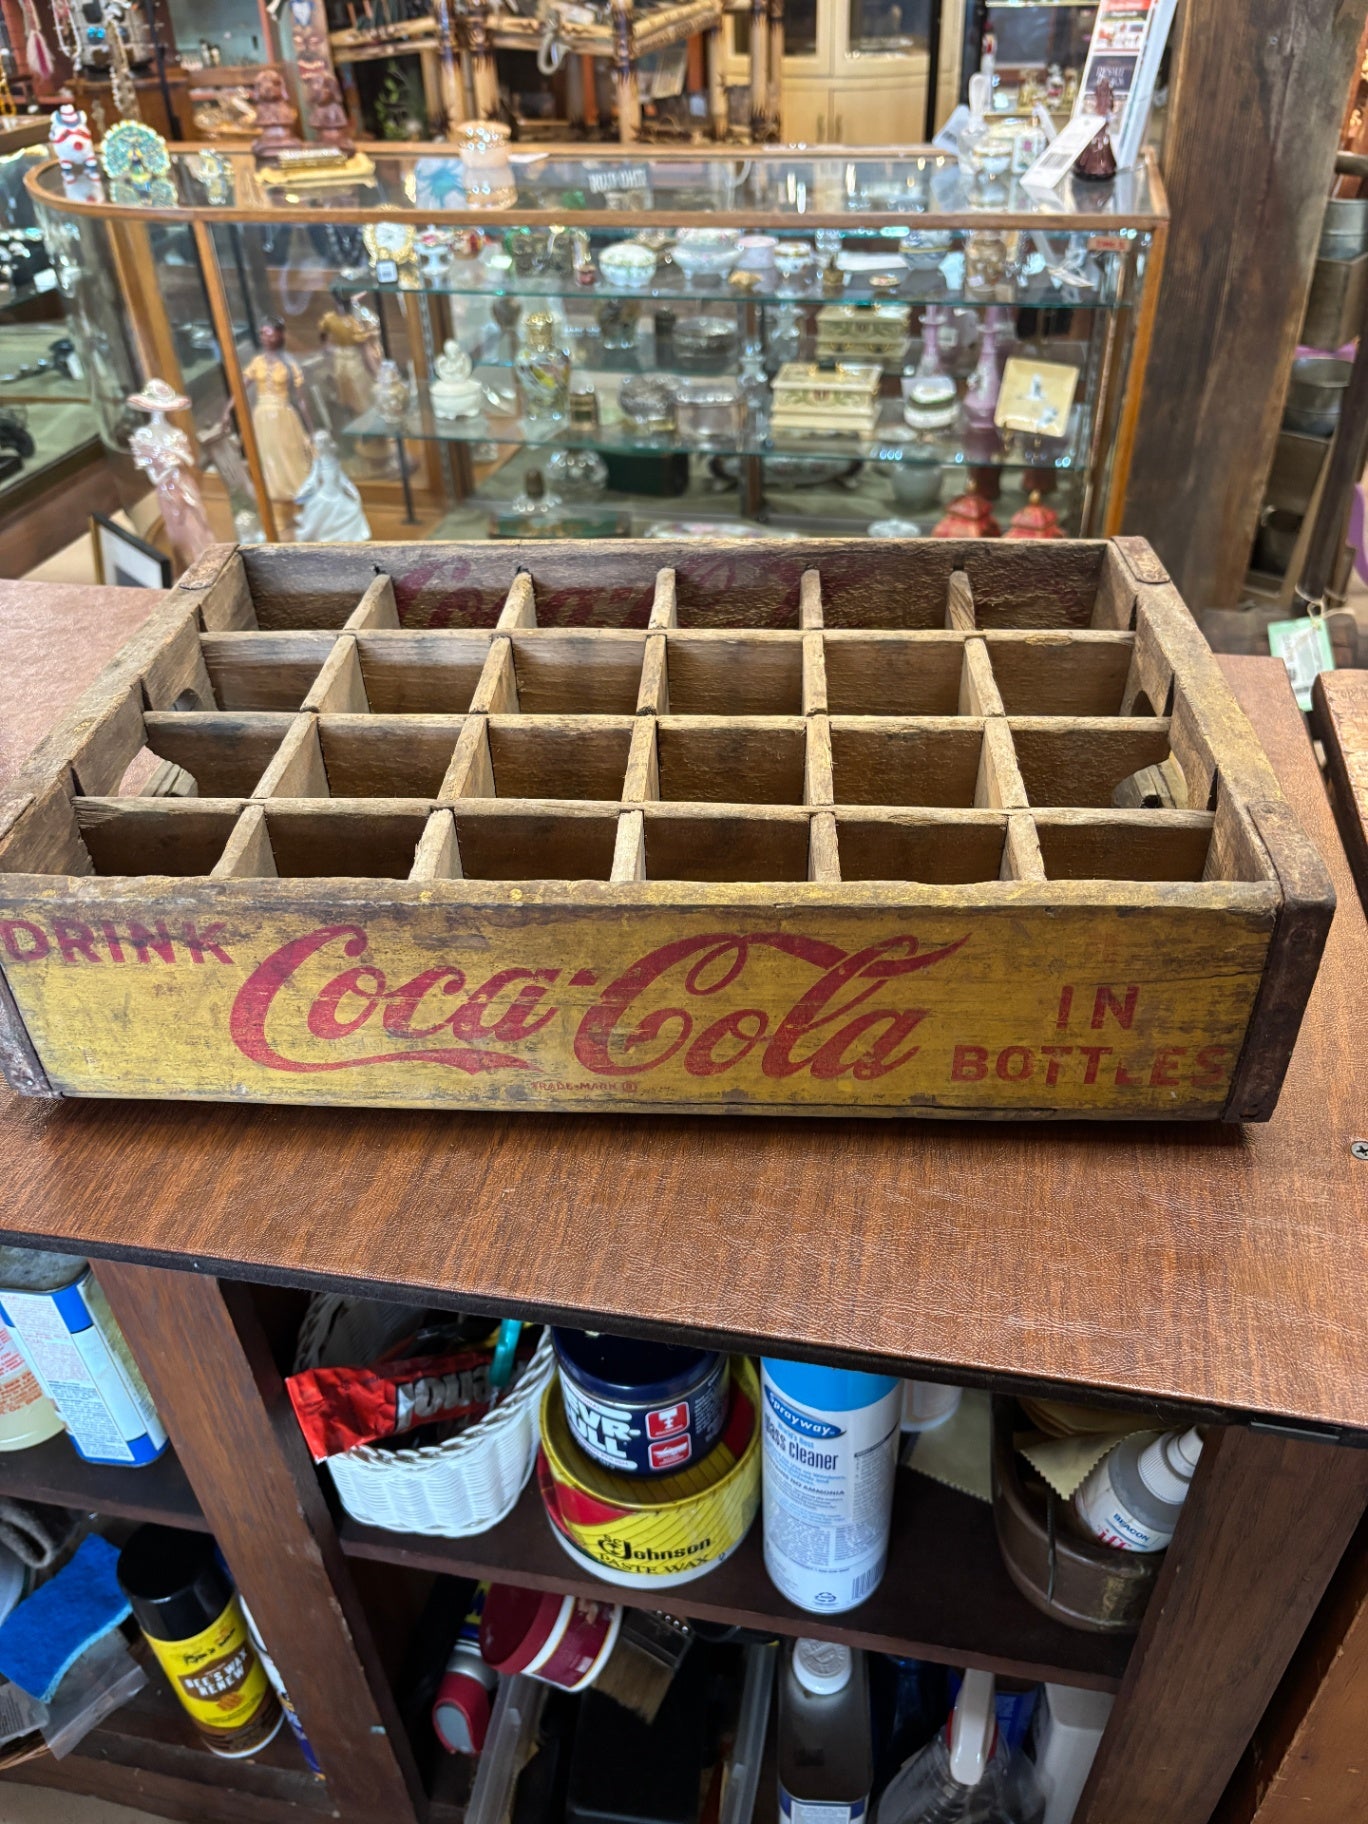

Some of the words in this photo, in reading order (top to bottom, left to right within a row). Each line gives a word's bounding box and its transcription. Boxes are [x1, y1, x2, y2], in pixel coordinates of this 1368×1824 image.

[0, 918, 234, 964] DRINK
[229, 924, 972, 1081] Coca-Cola
[1056, 986, 1140, 1030] IN
[950, 1045, 1228, 1086] BOTTLES
[566, 1402, 628, 1459] ULL
[769, 1391, 832, 1437] Sprayway
[764, 1413, 787, 1452] lass
[788, 1441, 839, 1471] cleaner
[620, 1537, 711, 1561] Johnson
[1113, 1513, 1151, 1541] BEACON
[599, 1552, 659, 1575] PASTE
[664, 1555, 710, 1575] WAX
